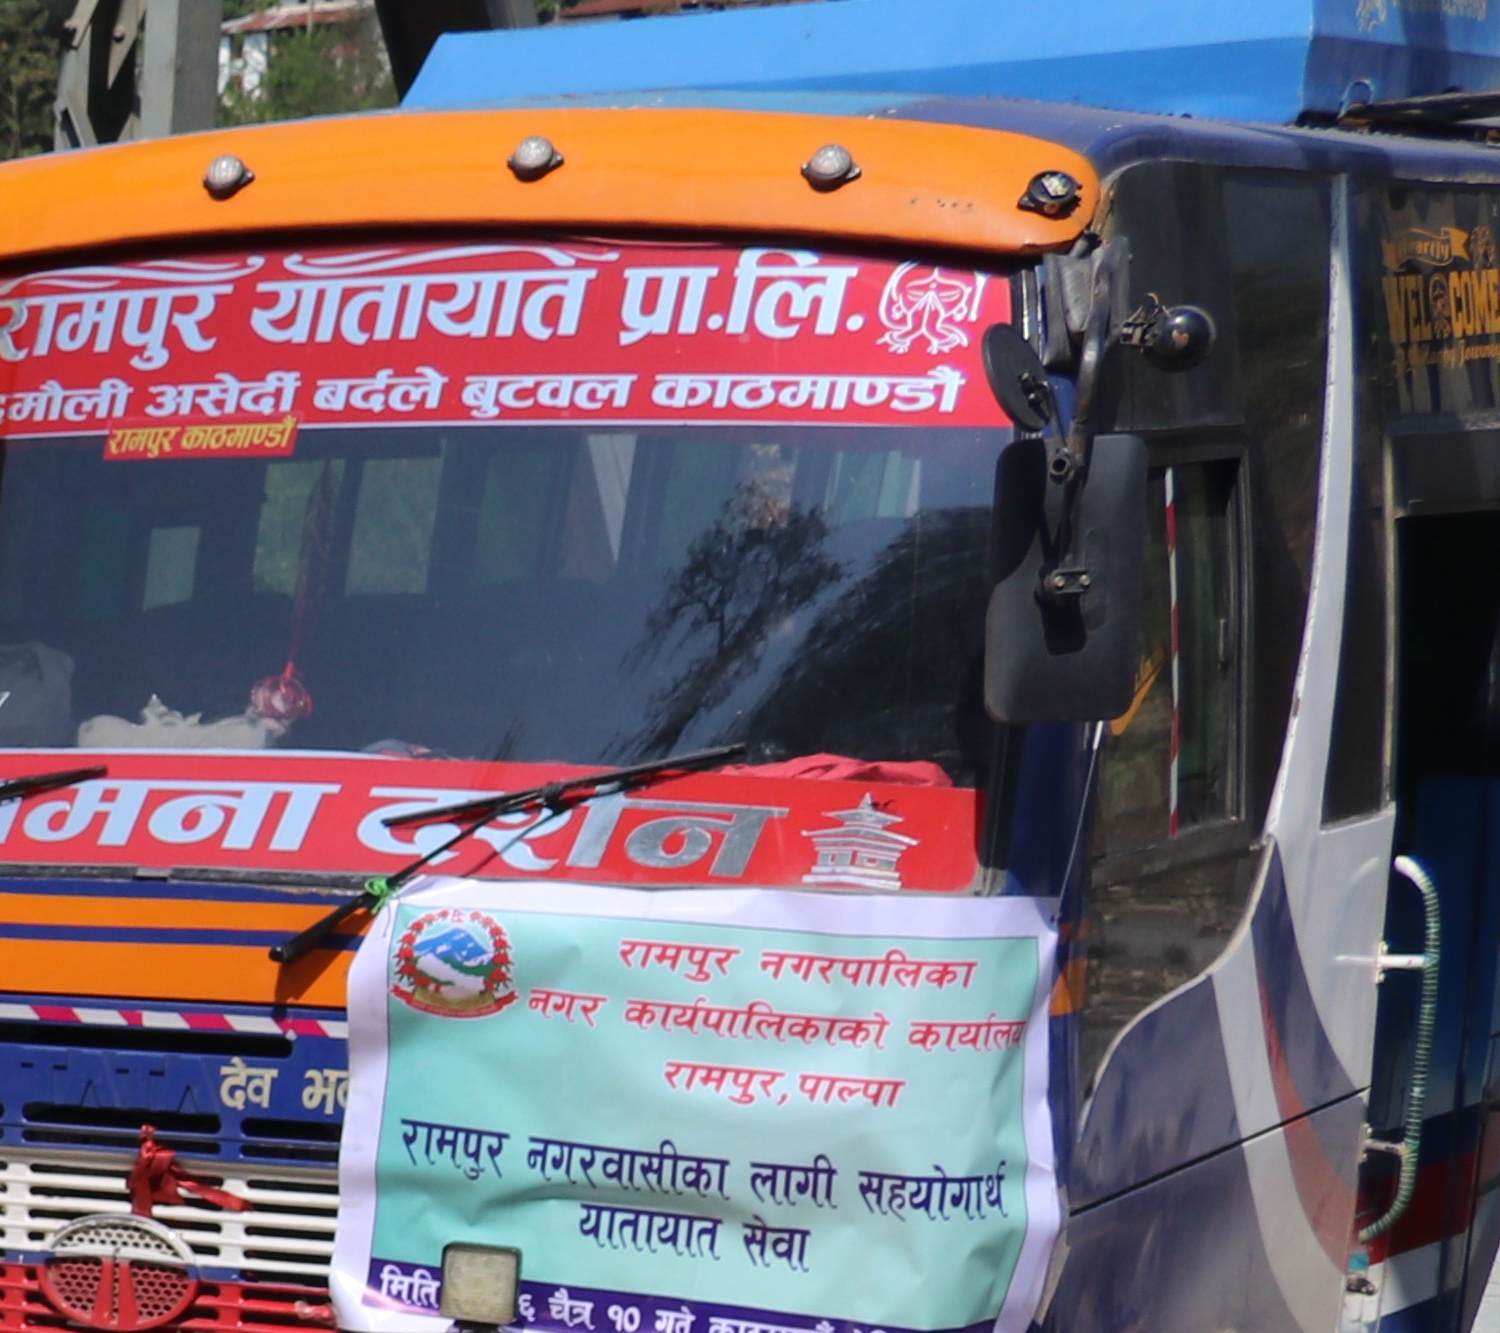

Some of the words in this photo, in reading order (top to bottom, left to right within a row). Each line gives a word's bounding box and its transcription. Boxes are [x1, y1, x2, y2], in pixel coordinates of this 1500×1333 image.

[250, 262, 597, 343] यातायात
[619, 250, 864, 346] प्रा.लि.
[312, 367, 447, 412] बर्दले
[461, 373, 636, 418] बुटवल
[109, 425, 181, 458] रामपुर
[619, 938, 741, 982] रामपुर
[760, 947, 978, 991] नगरपालिका
[527, 988, 608, 1027] नगर
[623, 994, 889, 1050] कार्यपालिकाको
[220, 1055, 278, 1109] देव
[400, 1117, 510, 1182] रामपुर
[526, 1136, 731, 1202] नगरवासीका
[750, 1153, 838, 1210] लागी
[580, 1202, 722, 1262] यातायात
[742, 1215, 812, 1273] सेवा
[380, 1265, 440, 1308] मिति
[548, 1288, 595, 1330] चैत्र
